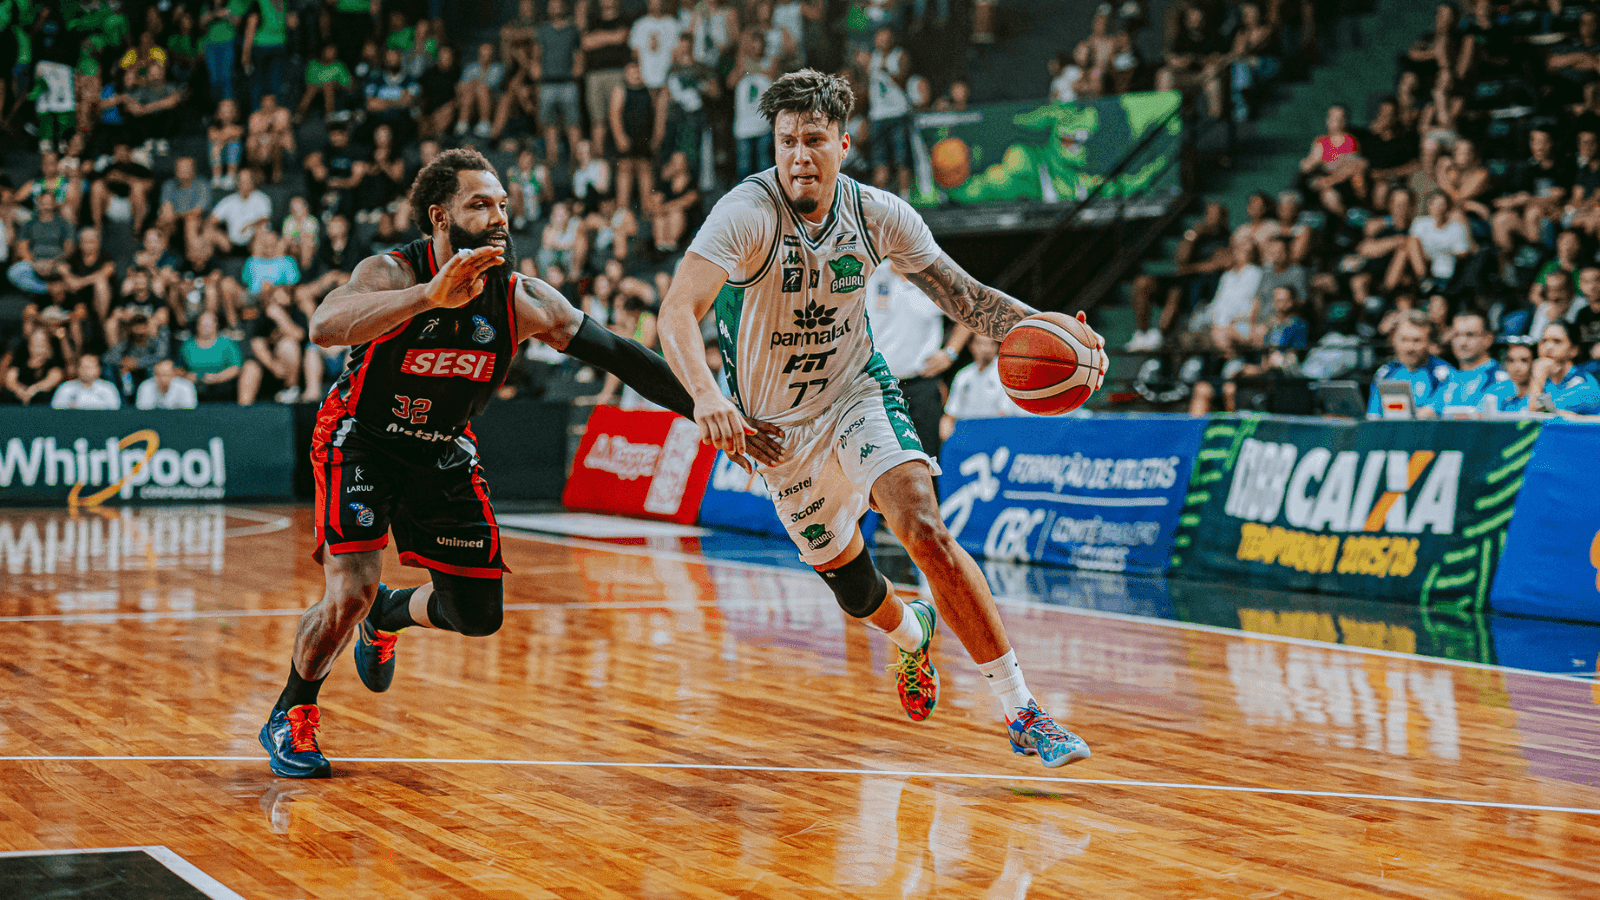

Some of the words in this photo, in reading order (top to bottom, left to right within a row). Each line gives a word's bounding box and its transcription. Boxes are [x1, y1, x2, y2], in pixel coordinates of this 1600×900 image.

[832, 275, 864, 292] BAURU
[770, 319, 851, 351] parmalat
[410, 352, 488, 379] SESI
[789, 378, 829, 409] 77
[392, 394, 432, 424] 32
[0, 436, 226, 500] Whirlpool
[1285, 447, 1464, 535] CAIXA
[790, 497, 825, 523] 3CORP
[436, 536, 484, 549] Unimed
[808, 530, 835, 551] BAURU
